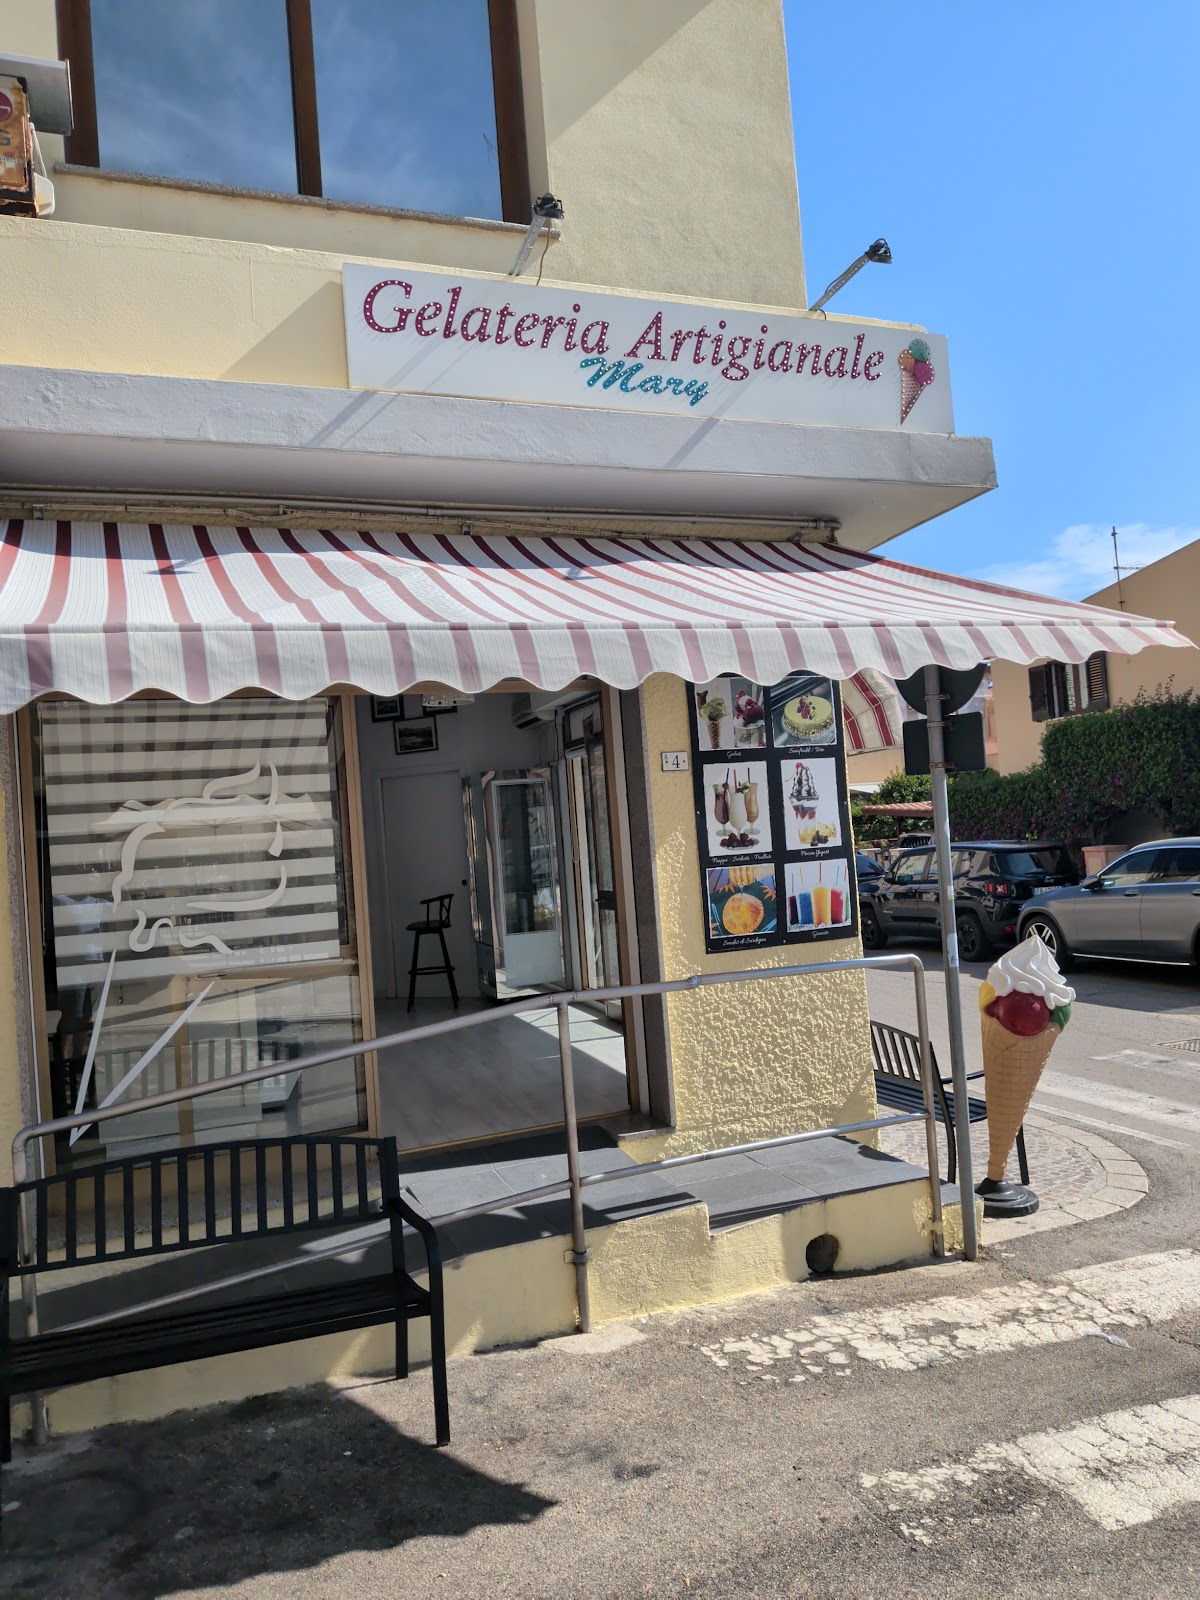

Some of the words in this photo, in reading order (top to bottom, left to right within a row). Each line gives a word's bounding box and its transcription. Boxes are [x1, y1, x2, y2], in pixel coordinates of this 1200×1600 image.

[363, 279, 611, 355] Gelateria
[623, 311, 884, 381] Artigianale
[580, 357, 710, 407] Mary
[671, 754, 681, 769] 4
